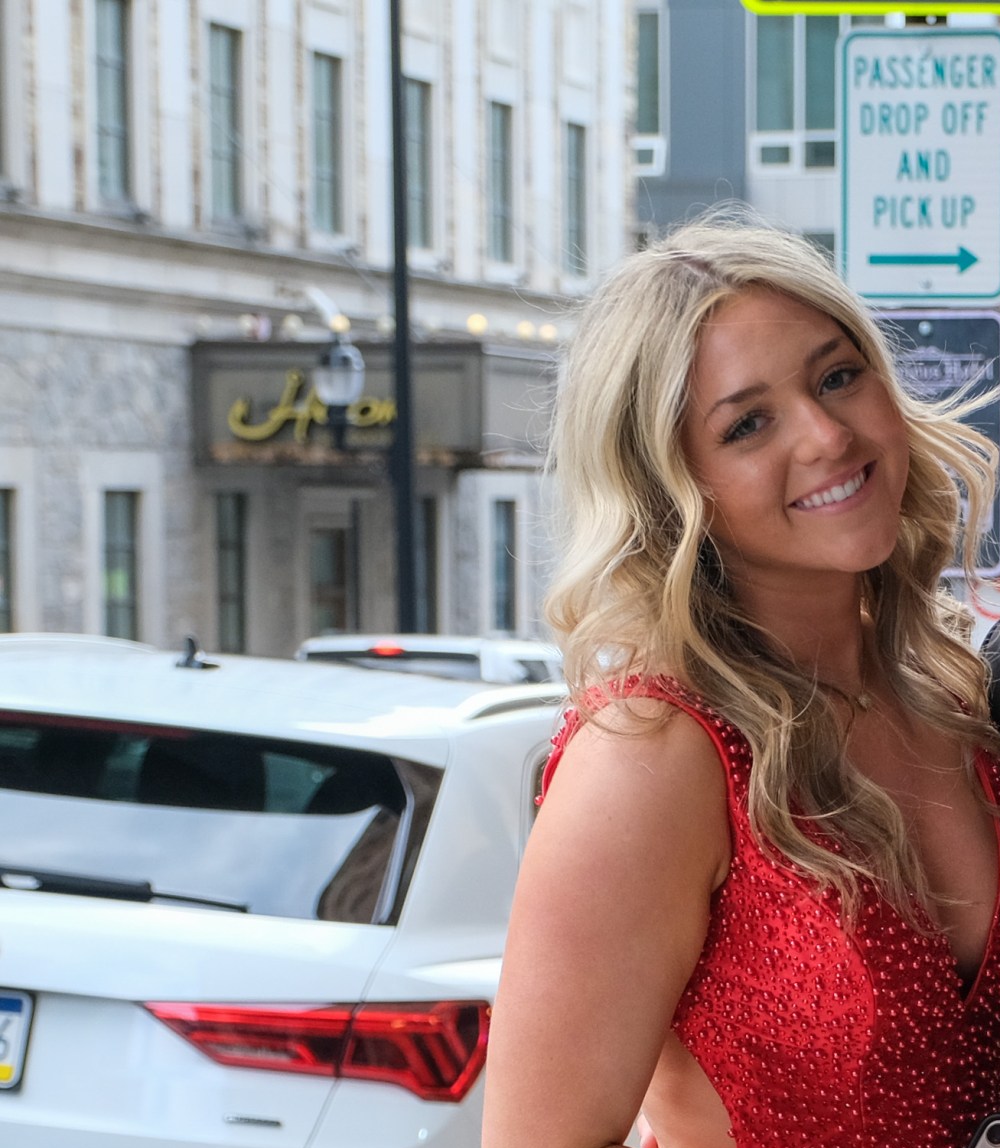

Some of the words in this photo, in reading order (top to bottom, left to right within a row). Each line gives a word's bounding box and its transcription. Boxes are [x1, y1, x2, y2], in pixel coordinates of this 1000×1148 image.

[854, 55, 996, 88] PASSENGER
[860, 102, 929, 135] DROP
[942, 102, 988, 135] OFF
[896, 149, 951, 181] AND
[873, 195, 932, 228] PICK
[941, 195, 976, 228] UP
